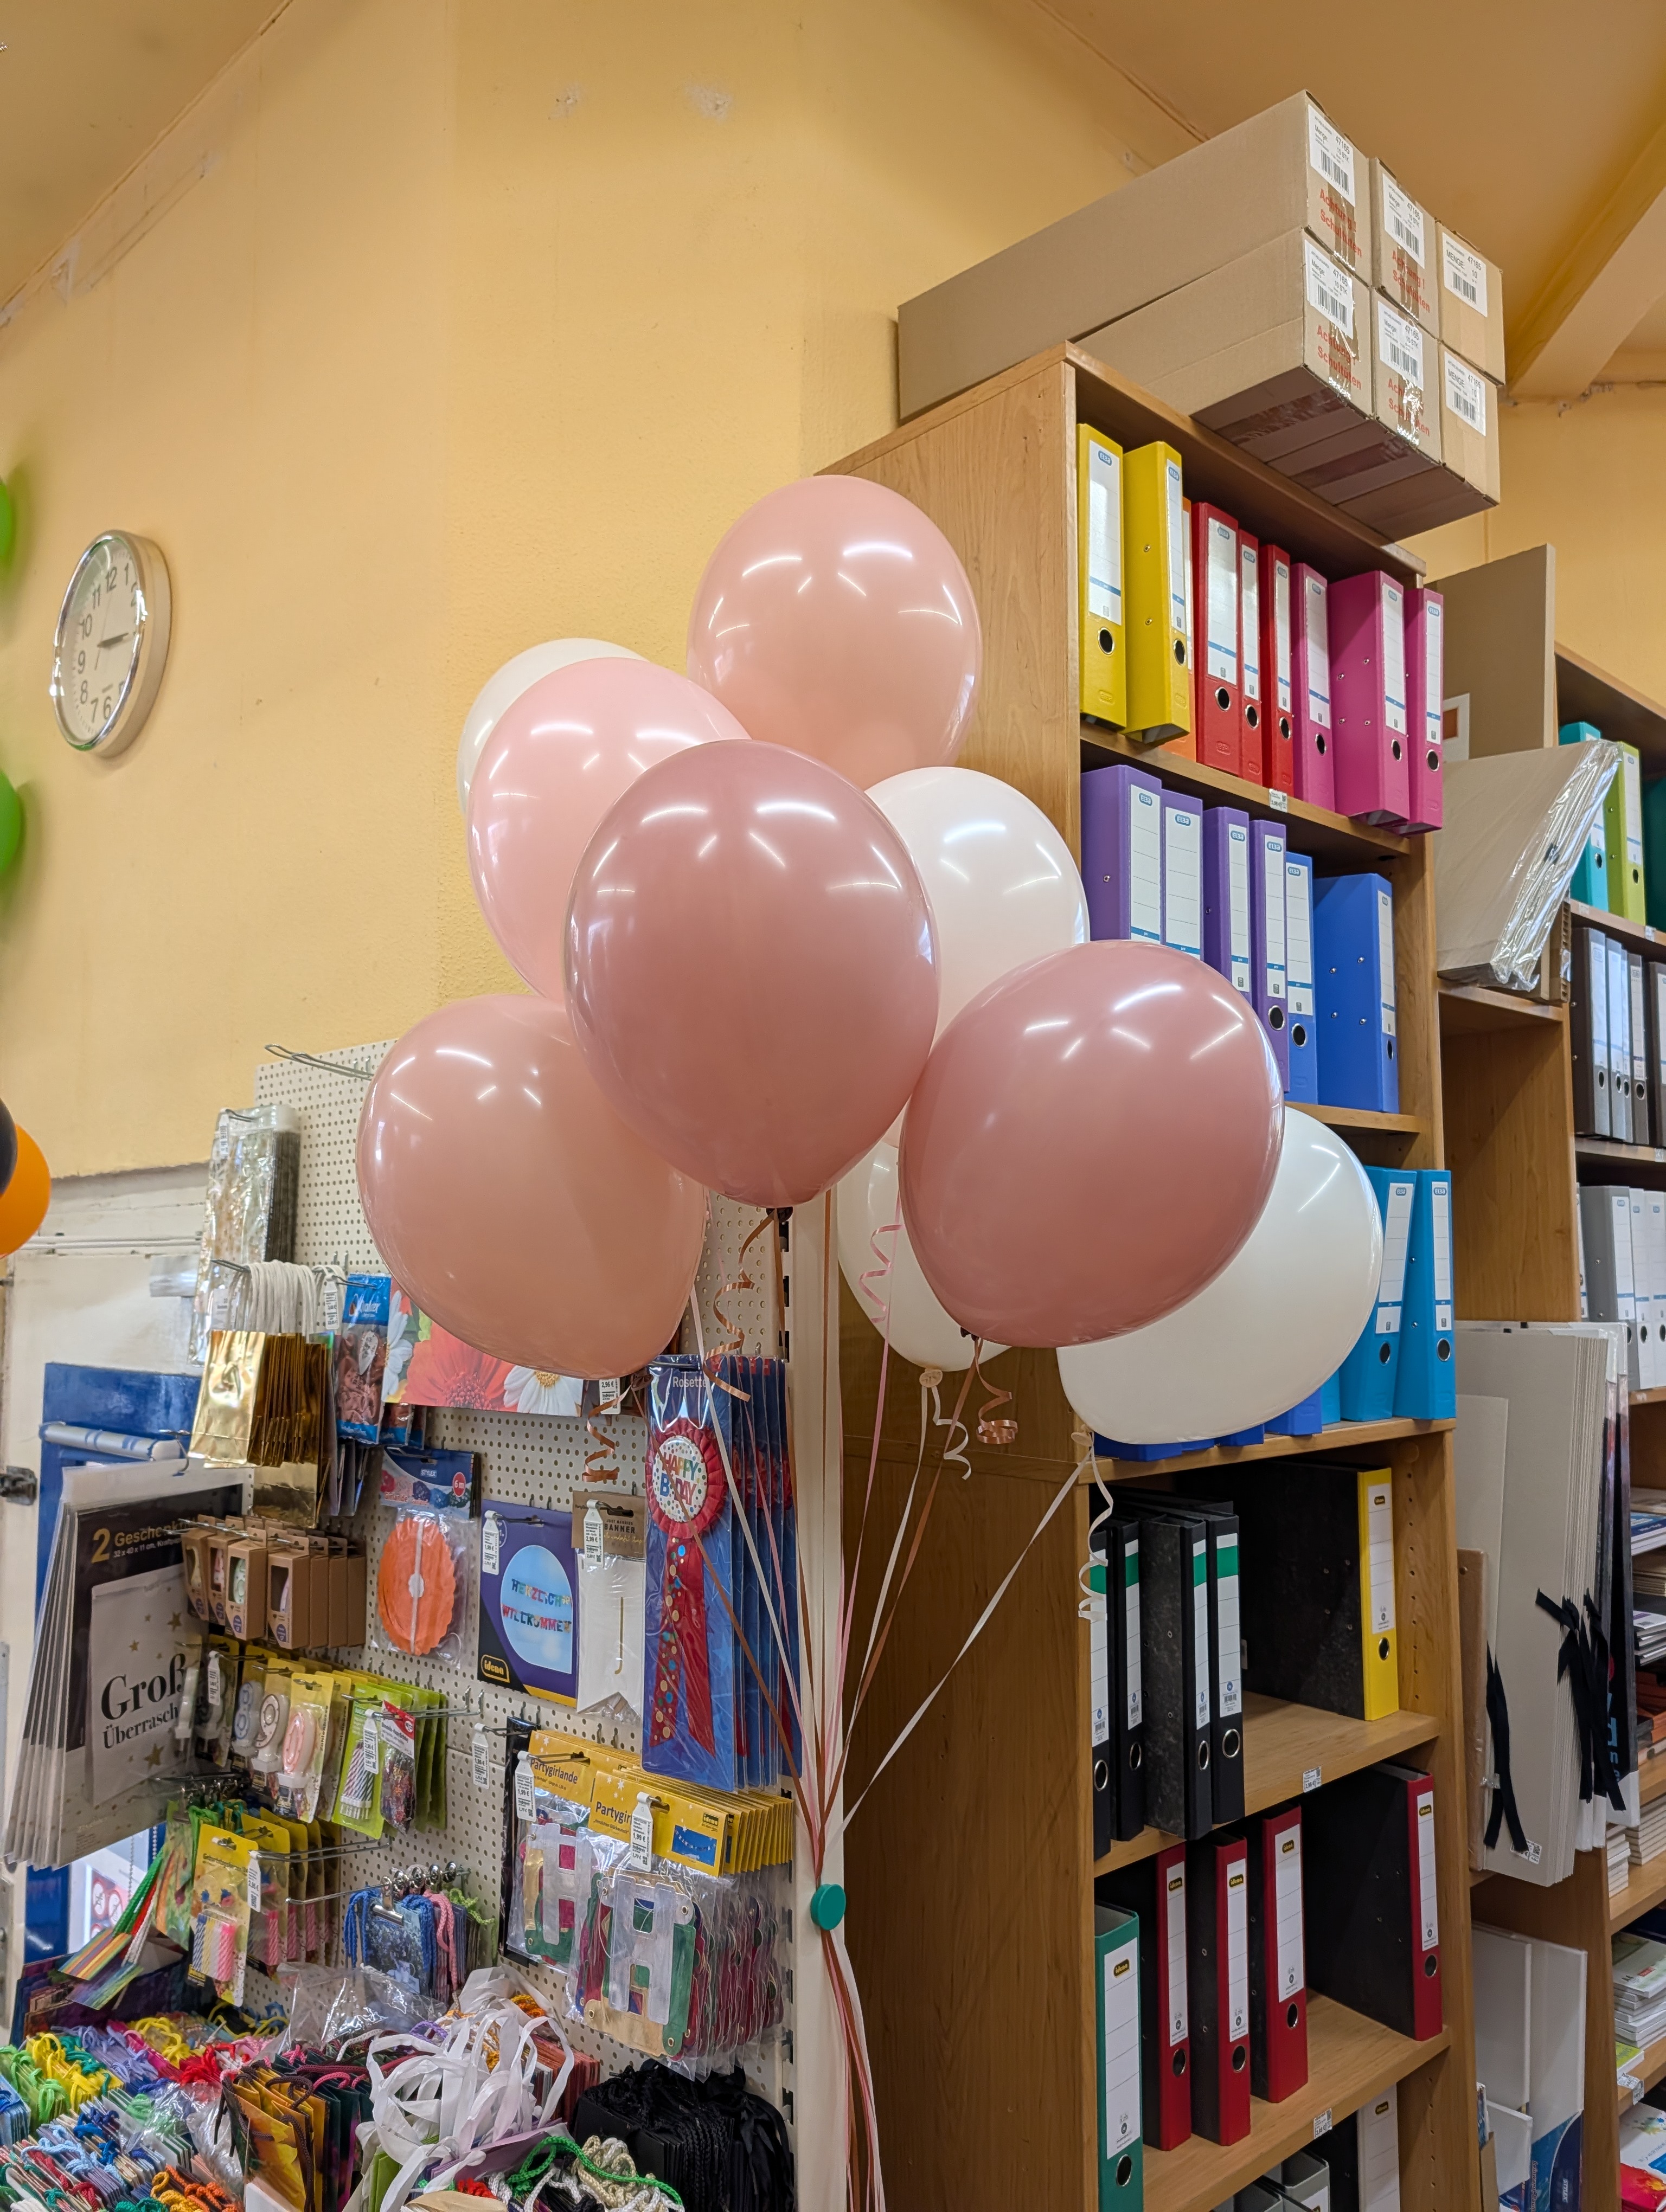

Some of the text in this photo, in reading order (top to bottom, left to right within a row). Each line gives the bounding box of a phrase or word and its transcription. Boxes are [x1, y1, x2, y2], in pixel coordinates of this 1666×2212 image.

[1335, 136, 1350, 155] 47165
[1468, 256, 1482, 271] 47165
[1472, 269, 1477, 279] 10
[1333, 269, 1348, 287] 47165
[1317, 325, 1350, 364] Achtung
[1318, 345, 1361, 390] Schultüten
[106, 566, 117, 594] 12
[124, 563, 130, 585] 1
[92, 584, 101, 609] 11
[80, 614, 92, 640] 10
[78, 651, 86, 674] 9
[80, 680, 88, 704] 8
[91, 698, 98, 723] 7
[102, 697, 111, 719] 6
[673, 1376, 707, 1388] Rosette
[662, 1452, 700, 1481] HAPPY
[604, 1523, 636, 1534] BANNER
[91, 1528, 110, 1564] 2
[502, 1604, 572, 1634] WILLKOMMEN
[484, 1661, 504, 1675] idena
[101, 1654, 187, 1720] Groß
[103, 1702, 178, 1749] Überrasch
[531, 1758, 578, 1784] Partygirlande
[595, 1801, 632, 1825] Partygirl
[703, 1814, 717, 1825] idena
[1115, 1963, 1128, 1975] idena
